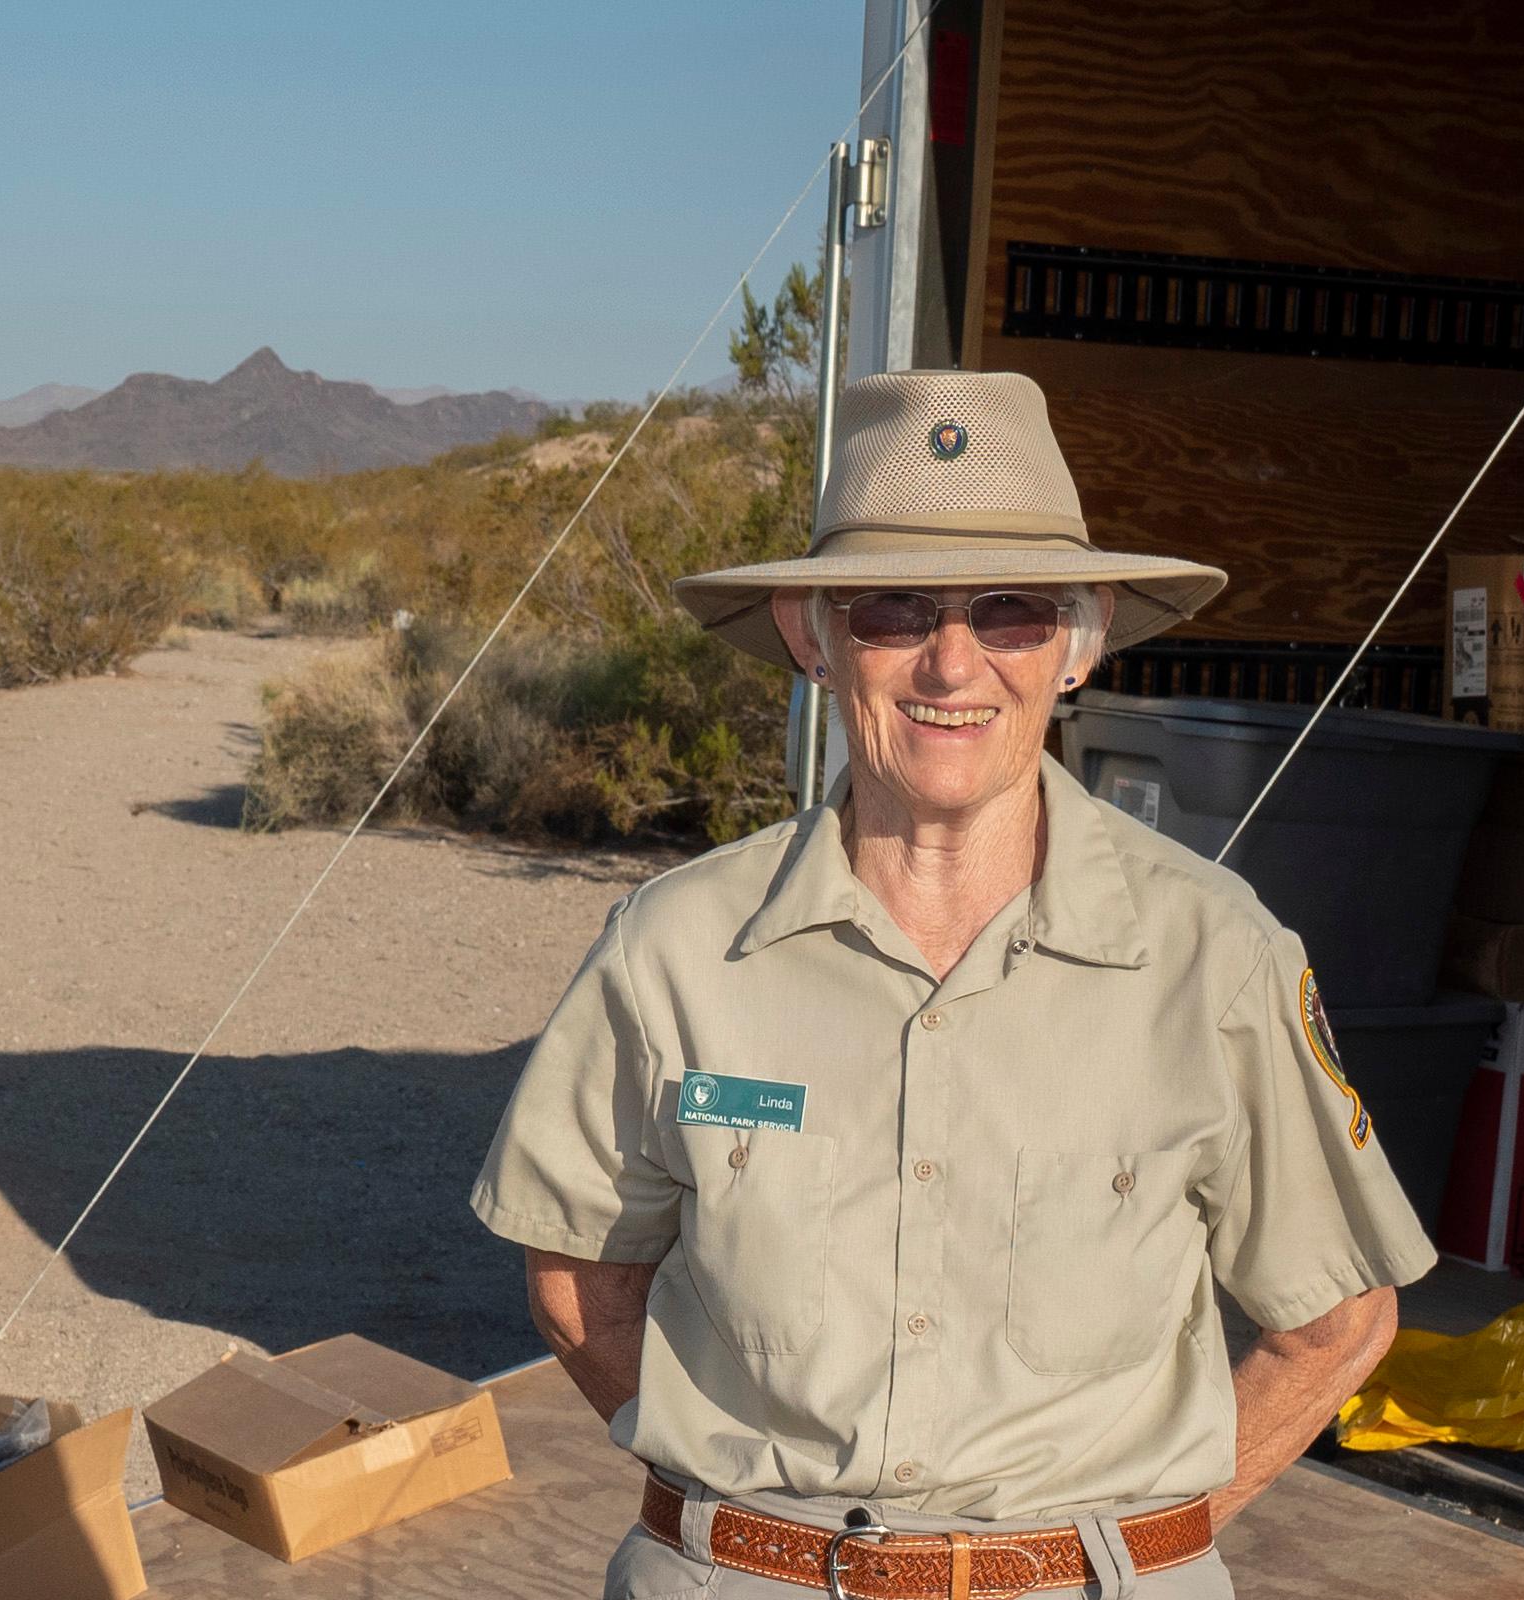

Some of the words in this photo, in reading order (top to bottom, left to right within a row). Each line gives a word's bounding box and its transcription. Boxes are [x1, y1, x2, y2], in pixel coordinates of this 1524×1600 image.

[758, 1095, 793, 1110] Linda
[685, 1111, 729, 1124] NATIONAL
[731, 1116, 755, 1128] PARK
[757, 1120, 796, 1134] SERVICE
